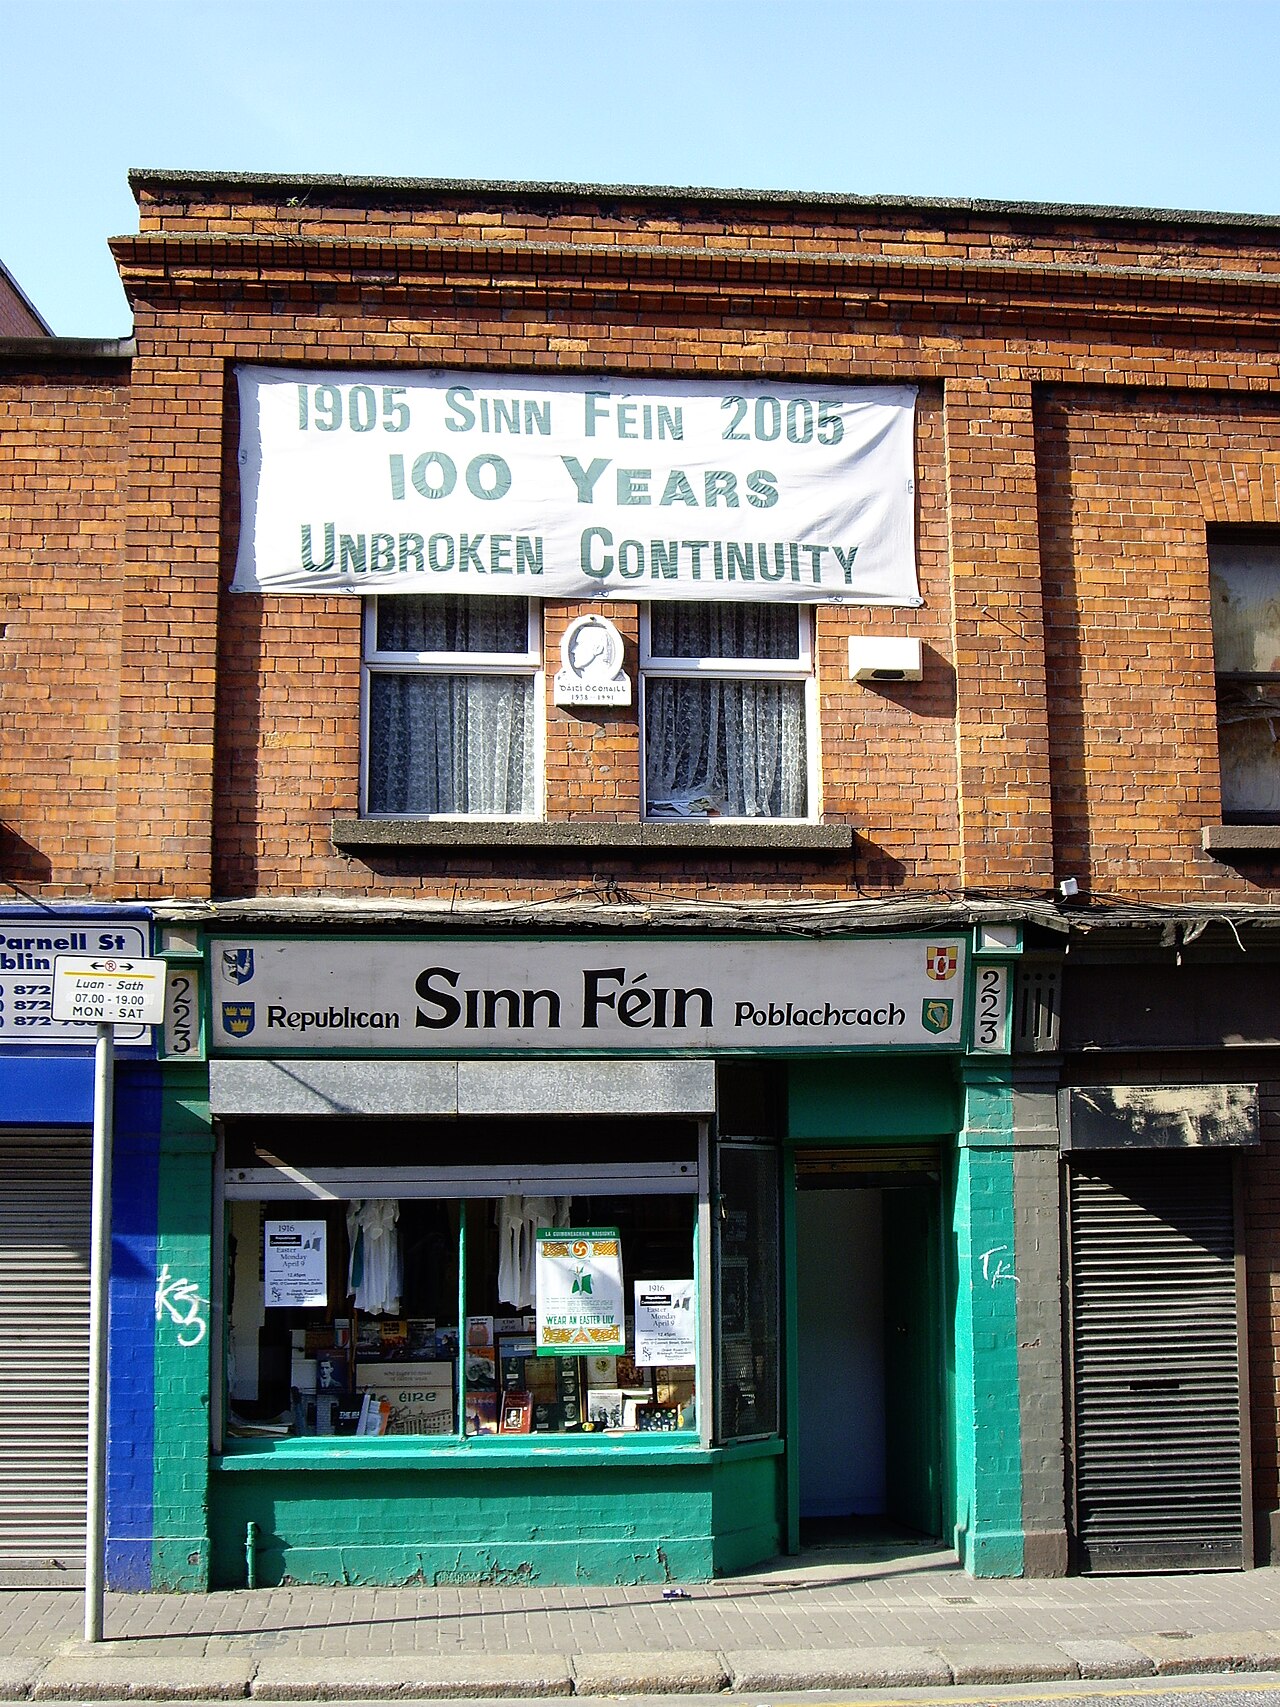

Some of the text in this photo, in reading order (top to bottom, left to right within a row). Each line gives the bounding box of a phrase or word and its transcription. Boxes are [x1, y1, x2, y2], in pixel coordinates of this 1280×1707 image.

[297, 383, 846, 446] 1905 SINN FÉIN 2005
[388, 450, 779, 508] 100 YEARS
[300, 522, 861, 586] UNBROKEN CONTINUITY
[98, 933, 126, 951] St
[13, 984, 51, 995] 872
[76, 978, 105, 990] Luan
[116, 980, 144, 991] Sath
[13, 1000, 51, 1010] 872
[75, 993, 105, 1004] 07.00
[116, 995, 144, 1006] 19.00
[267, 965, 906, 1032] Republican Sinn Féin Poblachtach
[72, 1006, 104, 1017] MON
[118, 1008, 144, 1019] SAT
[979, 970, 1002, 1045] 223
[13, 1016, 52, 1026] 872
[170, 977, 192, 1054] 223
[546, 1314, 615, 1325] WEAR AN EASTER LILY
